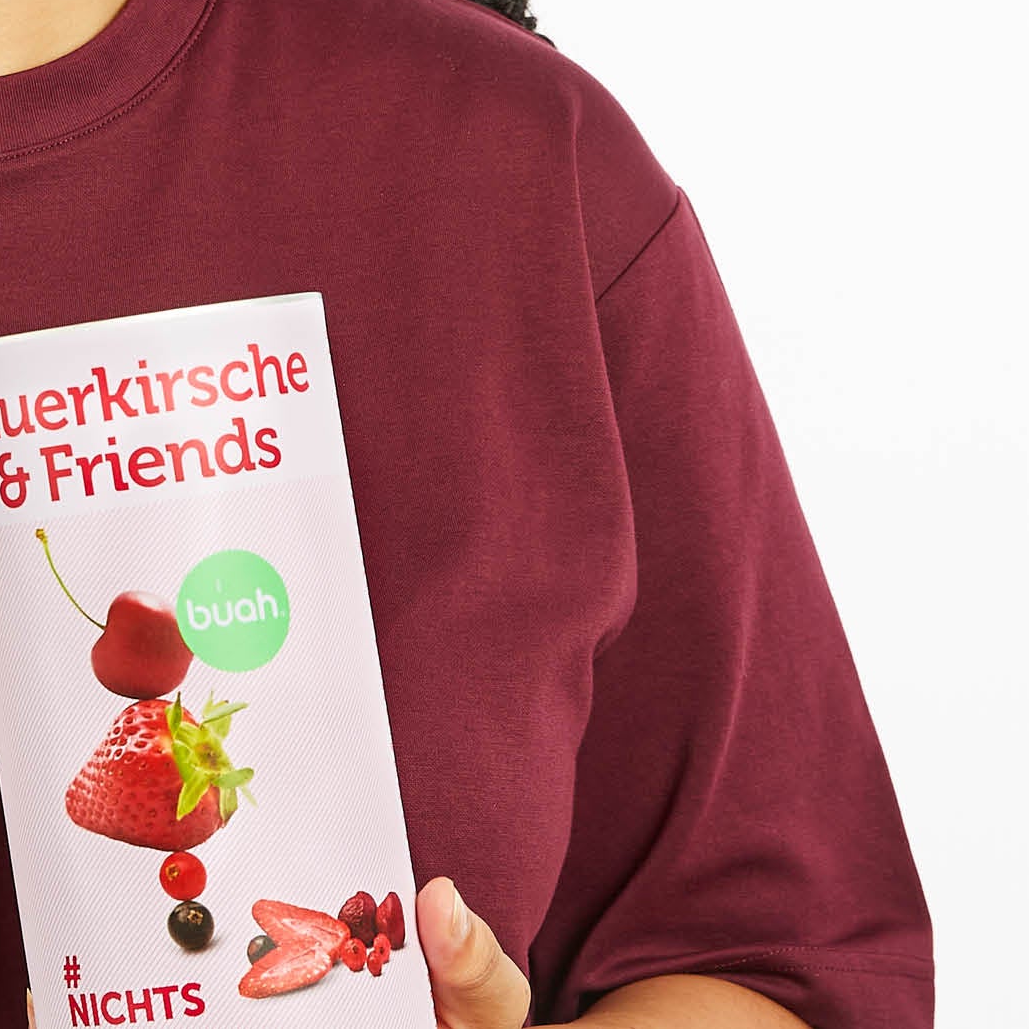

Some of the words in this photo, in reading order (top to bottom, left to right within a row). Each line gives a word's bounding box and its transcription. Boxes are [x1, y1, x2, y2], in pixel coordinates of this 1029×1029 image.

[38, 417, 283, 503] Friends
[63, 955, 81, 989] #
[67, 982, 206, 1027] NICHTS
